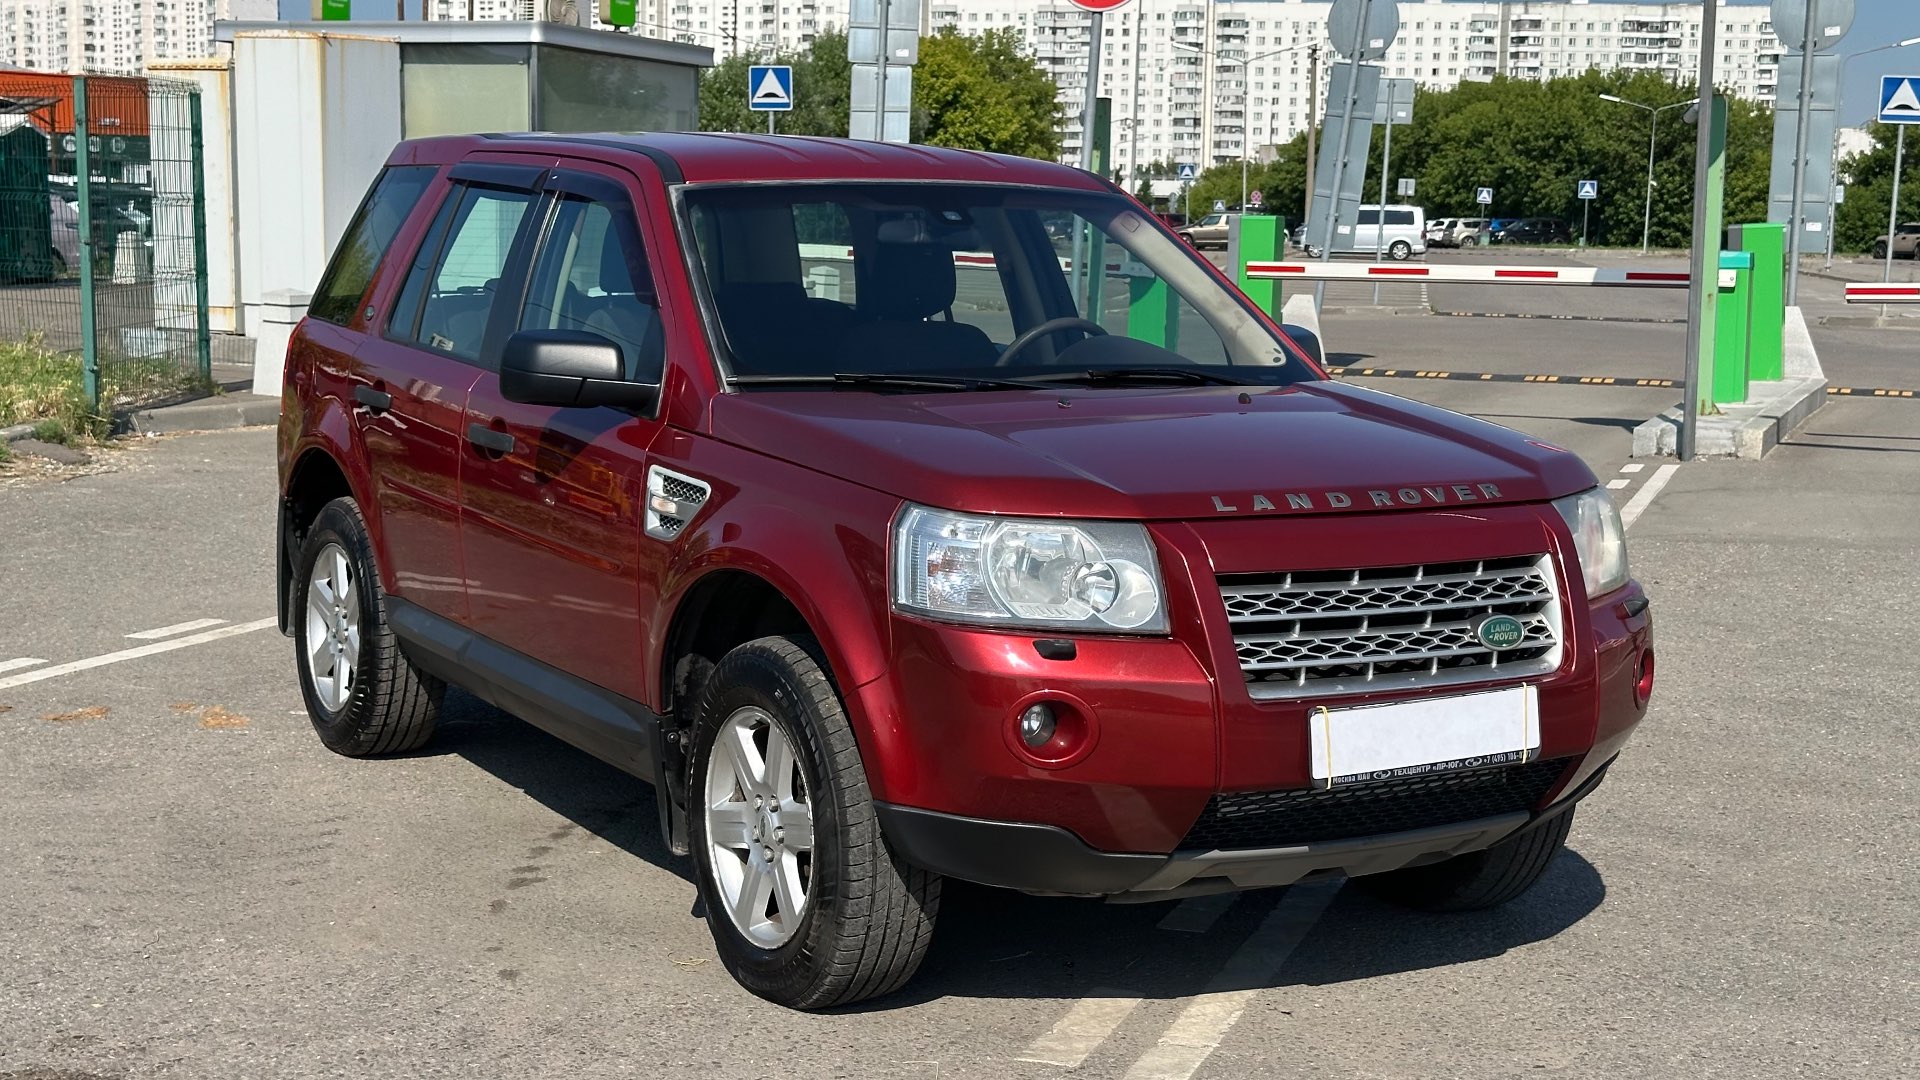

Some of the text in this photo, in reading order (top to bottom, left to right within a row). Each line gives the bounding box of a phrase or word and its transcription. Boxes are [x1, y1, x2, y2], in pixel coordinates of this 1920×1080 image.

[1210, 482, 1504, 513] LAND ROVER
[1393, 764, 1431, 776] ТЕХЦЕНТР
